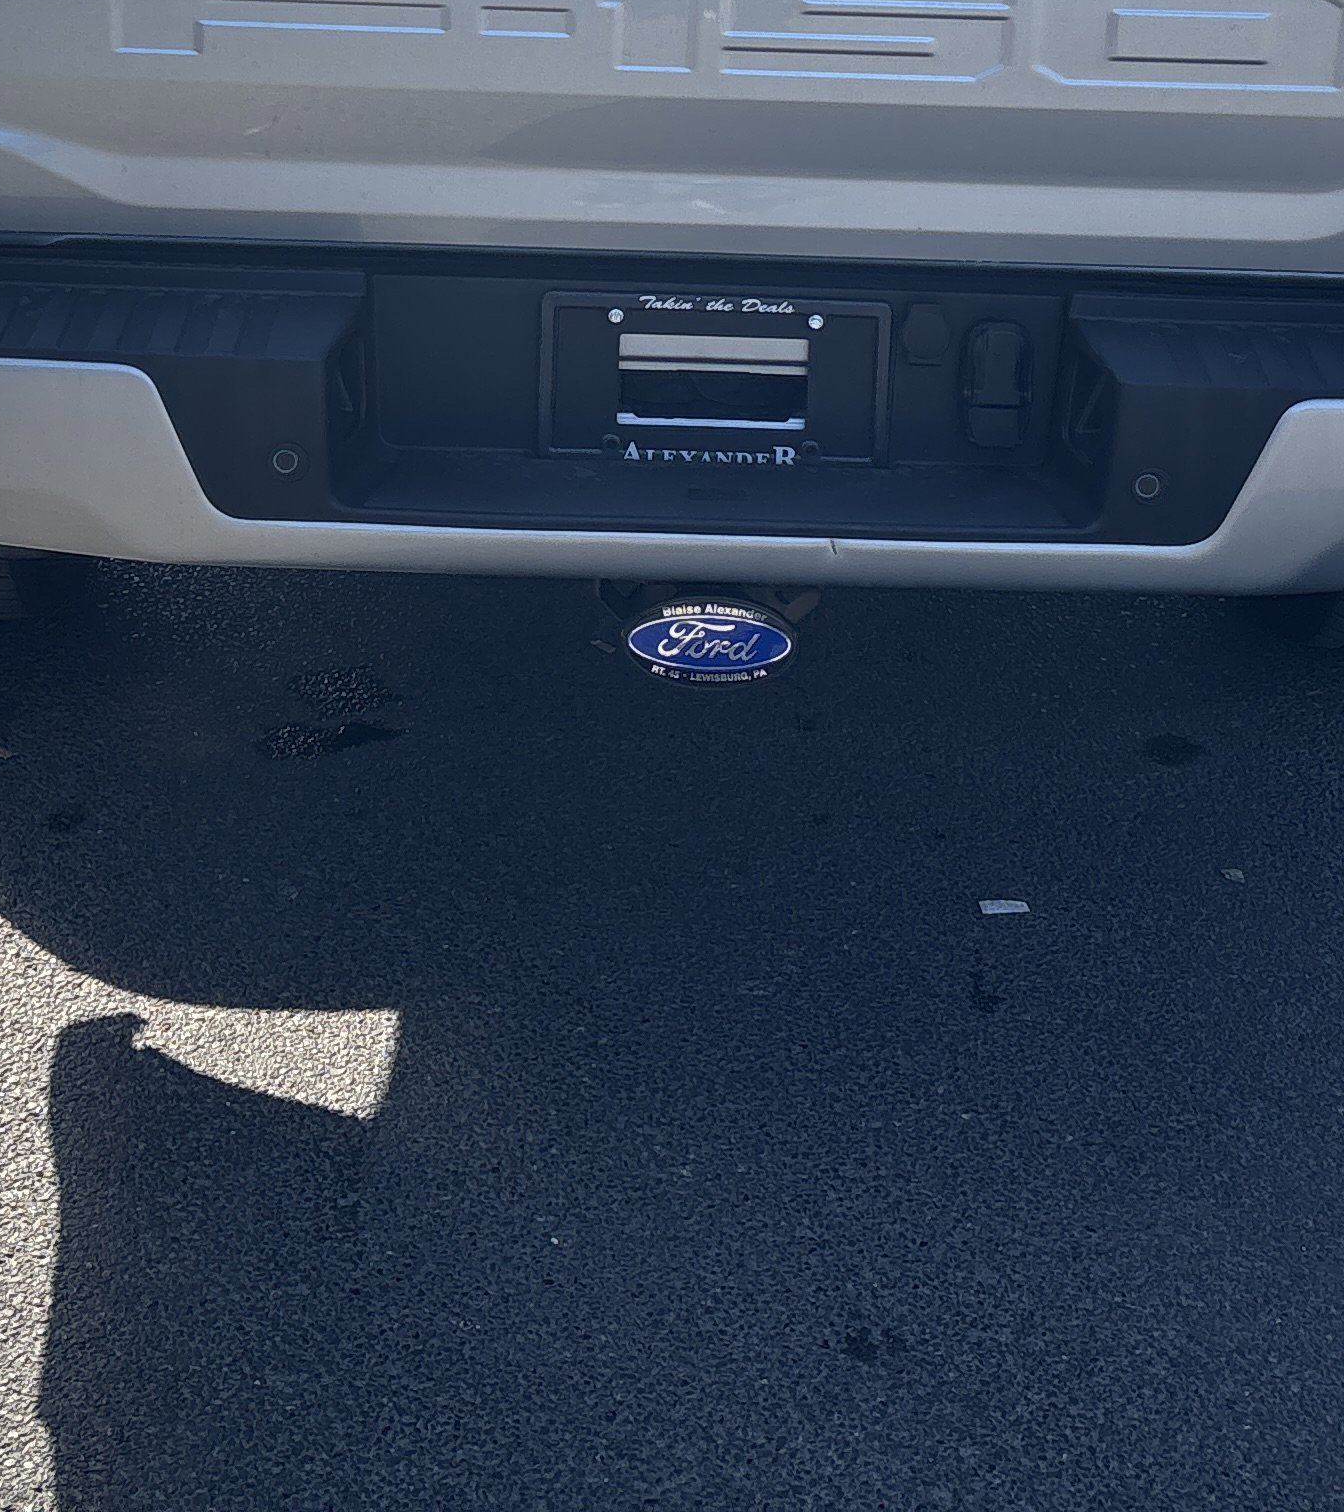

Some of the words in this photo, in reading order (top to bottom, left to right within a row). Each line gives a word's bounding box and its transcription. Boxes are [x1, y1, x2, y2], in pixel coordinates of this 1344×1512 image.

[639, 295, 701, 311] Takin'
[706, 298, 734, 312] the
[741, 298, 796, 314] Deals
[662, 606, 702, 617] Blaise
[705, 603, 768, 622] Alexander
[657, 620, 761, 661] Ford
[753, 669, 768, 679] PA
